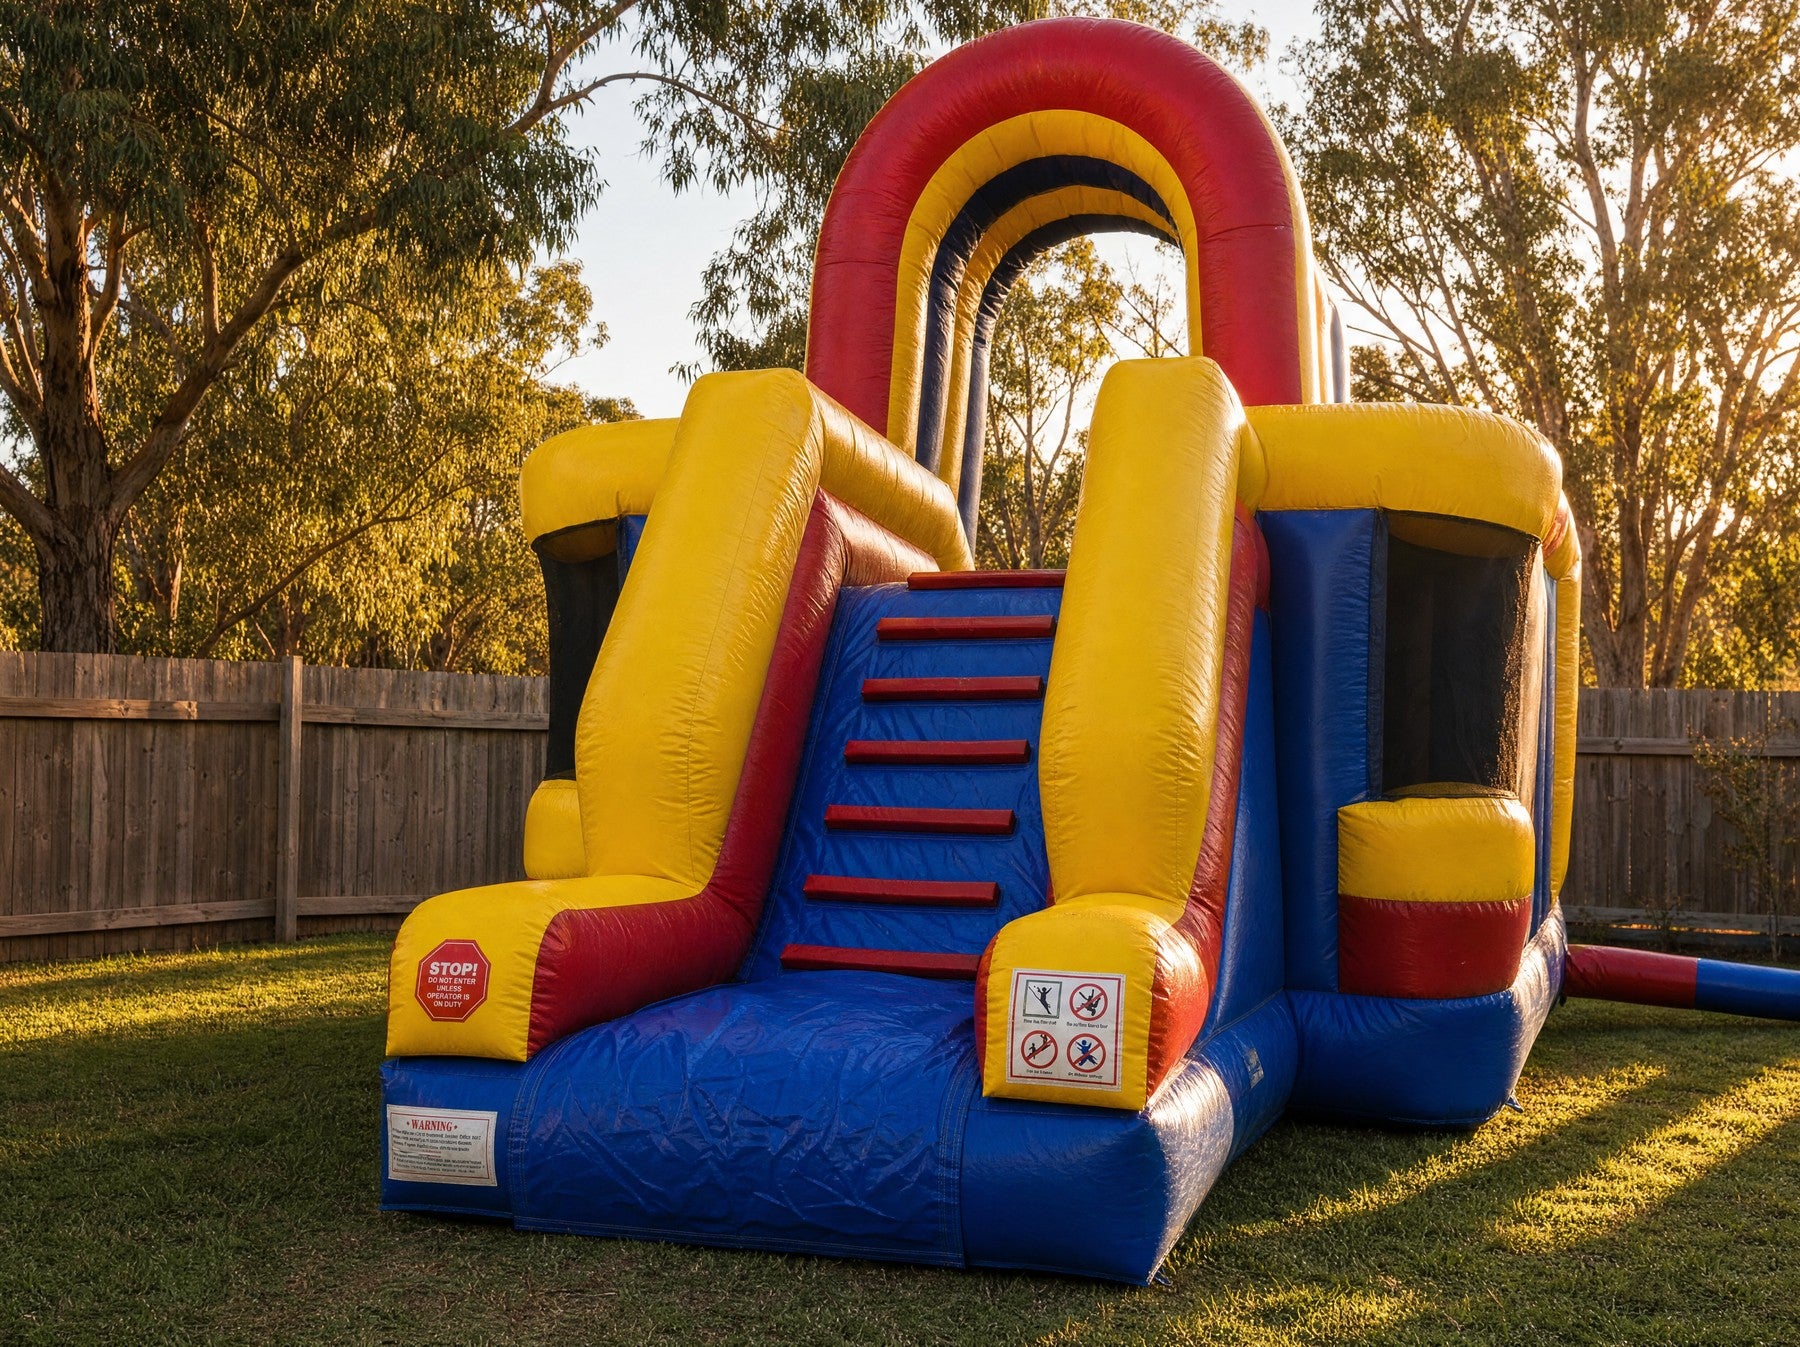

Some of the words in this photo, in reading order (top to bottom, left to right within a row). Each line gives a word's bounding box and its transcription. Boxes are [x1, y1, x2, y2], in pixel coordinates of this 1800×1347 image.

[429, 961, 478, 977] STOP!
[454, 977, 476, 985] ENTER
[426, 992, 462, 1000] OPERATOR
[411, 1119, 453, 1132] WARNING
